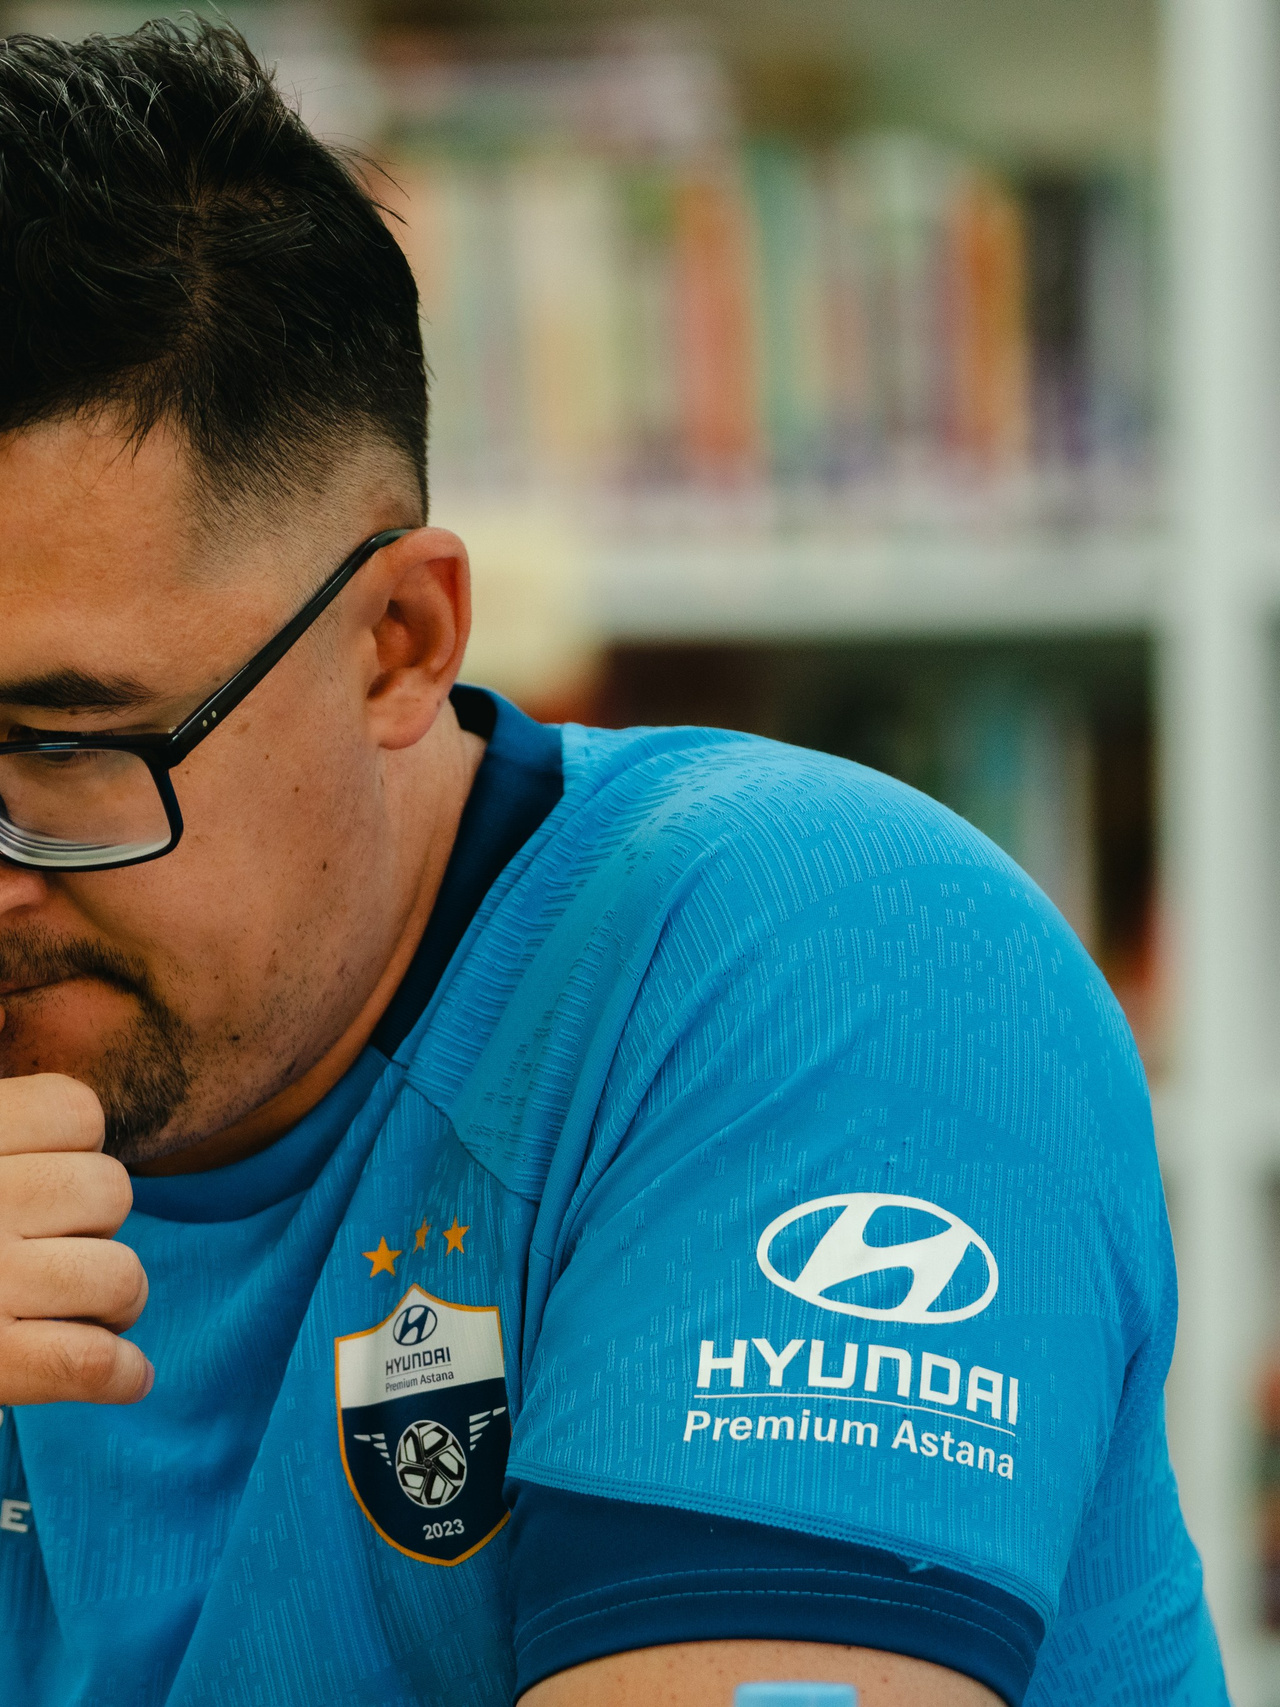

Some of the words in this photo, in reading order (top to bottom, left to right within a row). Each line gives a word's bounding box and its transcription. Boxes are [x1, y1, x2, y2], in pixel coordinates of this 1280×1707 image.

[385, 1346, 451, 1376] HYUNDAI
[385, 1377, 419, 1393] Premium
[420, 1371, 454, 1385] Astana
[696, 1338, 1018, 1425] HYUNDAI
[683, 1409, 878, 1447] Premium
[891, 1419, 1014, 1480] Astana
[422, 1519, 465, 1540] 2023
